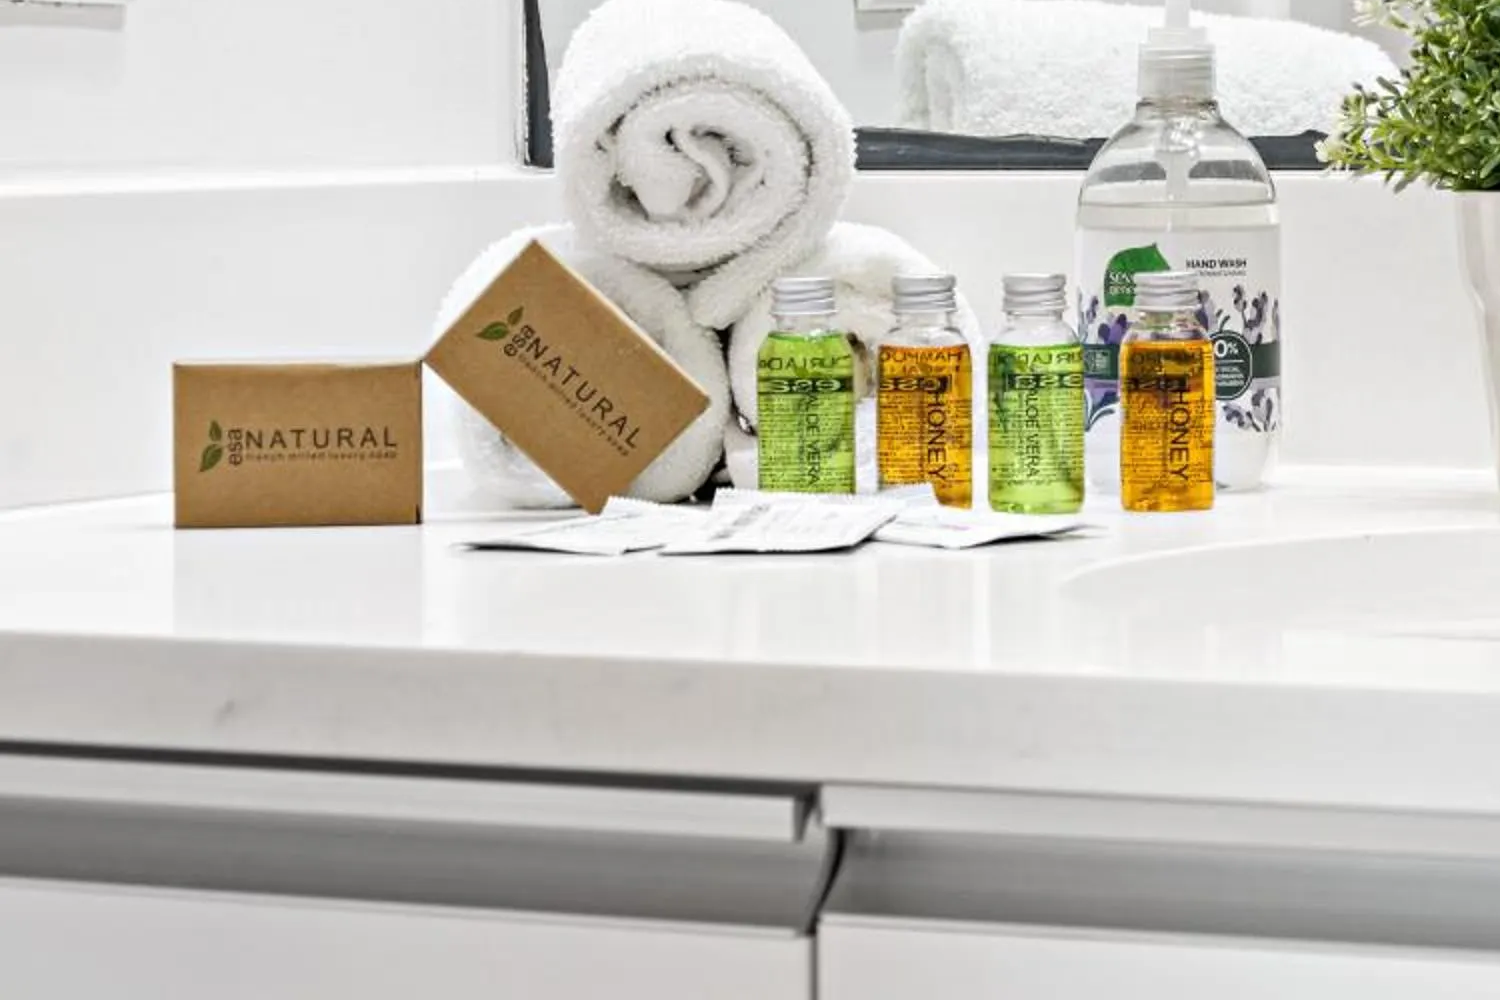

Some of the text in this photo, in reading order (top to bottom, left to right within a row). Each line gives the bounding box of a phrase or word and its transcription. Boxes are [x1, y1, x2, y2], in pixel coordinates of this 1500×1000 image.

[1186, 257, 1247, 269] HAND WASH
[503, 324, 536, 357] esa
[526, 337, 640, 449] NATURAL
[228, 428, 243, 466] esa
[245, 426, 397, 449] NATURAL
[927, 391, 947, 480] HONEY
[1025, 433, 1040, 477] VERA
[1169, 390, 1191, 480] HONEY
[806, 439, 821, 486] VERA
